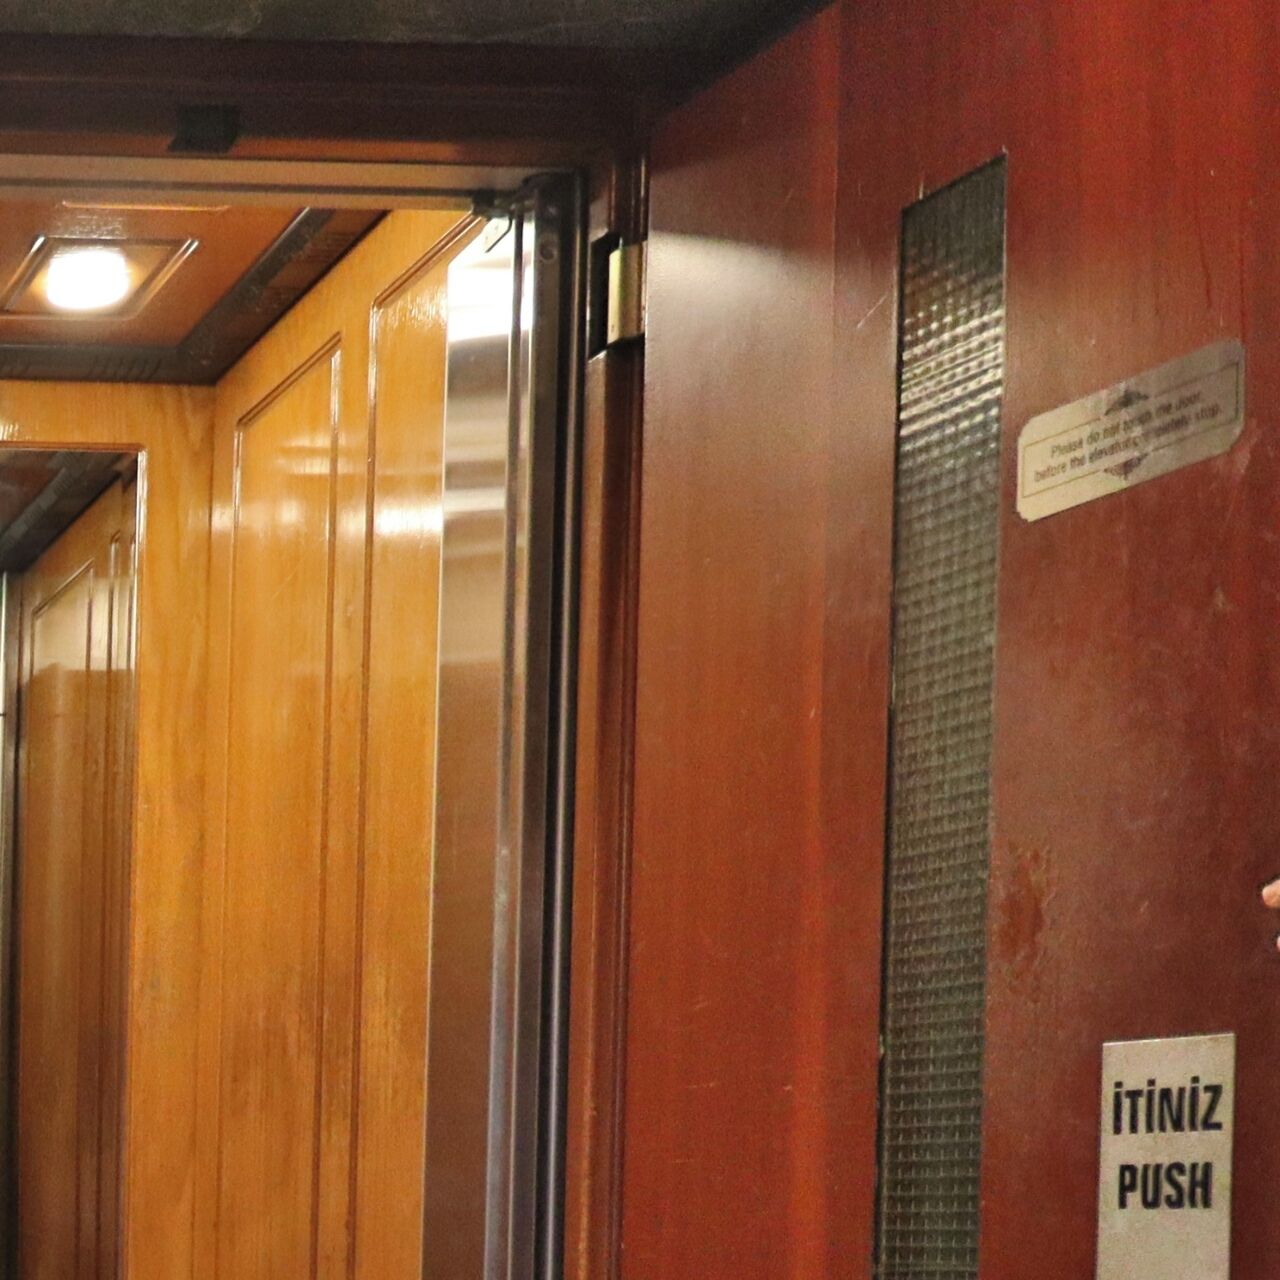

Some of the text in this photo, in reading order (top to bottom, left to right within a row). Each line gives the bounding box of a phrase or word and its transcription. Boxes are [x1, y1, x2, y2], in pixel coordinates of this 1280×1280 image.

[1086, 429, 1100, 446] do
[1033, 461, 1068, 482] before
[1070, 454, 1086, 468] the
[1112, 1076, 1224, 1135] İTİNİZ
[1117, 1162, 1213, 1210] PUSH
